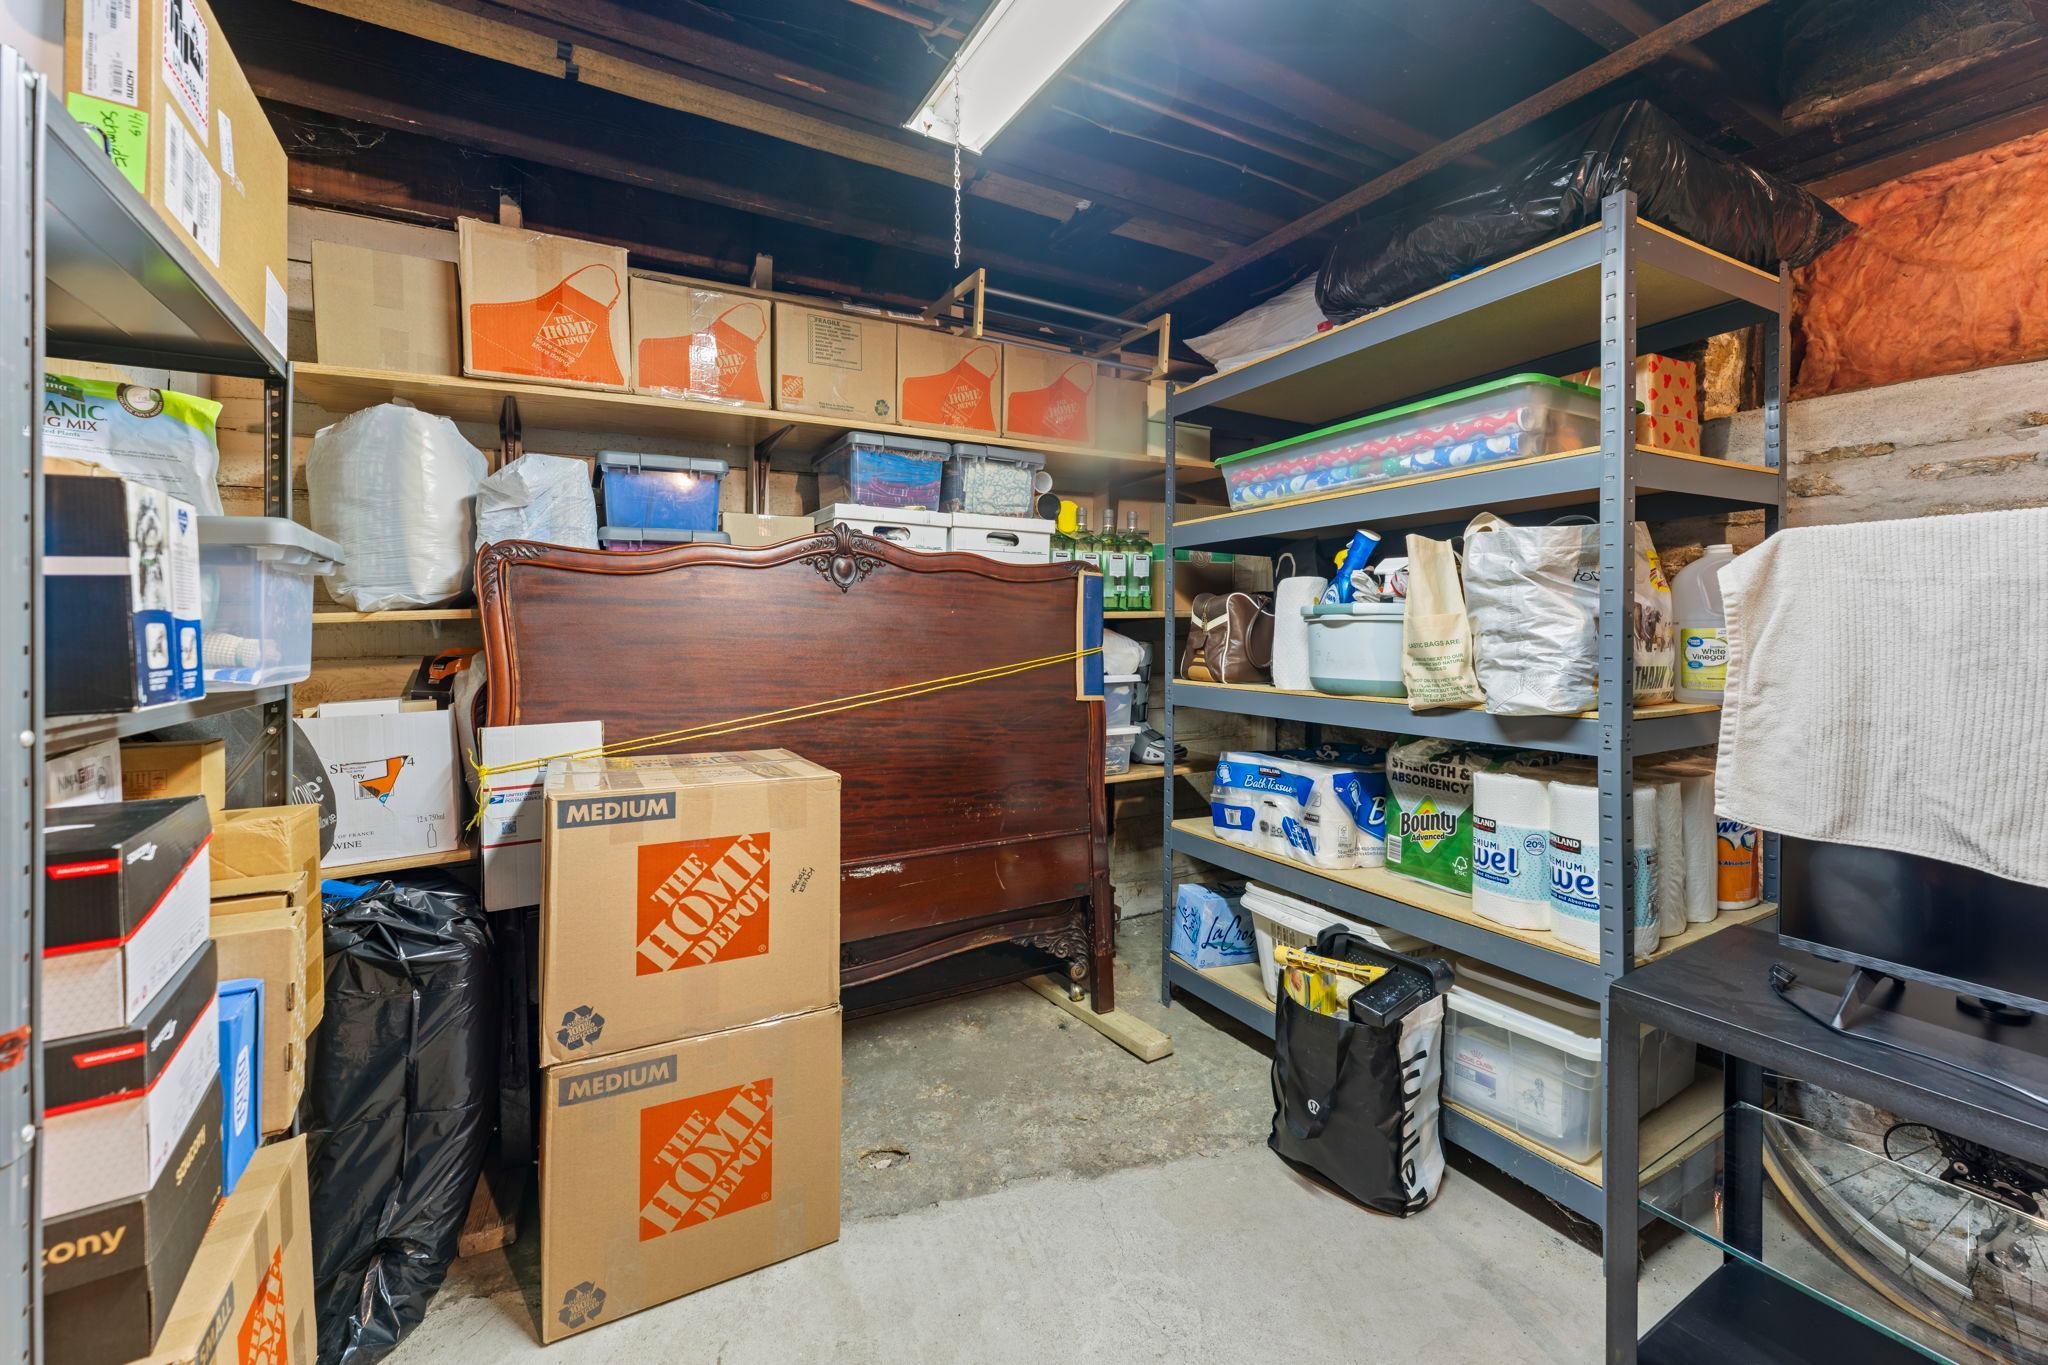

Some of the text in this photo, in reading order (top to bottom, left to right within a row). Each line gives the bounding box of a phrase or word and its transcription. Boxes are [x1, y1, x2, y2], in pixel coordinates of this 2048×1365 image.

[554, 315, 574, 323] THE
[542, 321, 594, 339] HOME
[557, 335, 588, 346] DEPOT
[948, 389, 980, 405] HOME
[67, 418, 97, 431] MIX
[1391, 771, 1469, 795] ABSORBENCY
[1460, 768, 1470, 781] &
[1244, 775, 1293, 793] Bath Tissue
[566, 798, 669, 823] MEDIUM
[1400, 811, 1457, 836] Bounty
[332, 840, 362, 850] WINE
[1411, 832, 1445, 841] Advanced
[1526, 840, 1544, 849] 20%
[650, 852, 709, 908] THE
[636, 833, 770, 971] HOME
[1567, 896, 1598, 909] Absorbent
[690, 879, 769, 965] DEPOT
[567, 1062, 669, 1100] MEDIUM
[653, 1109, 711, 1168] THE
[639, 1082, 773, 1233] HOME
[694, 1126, 772, 1220] DEPOT
